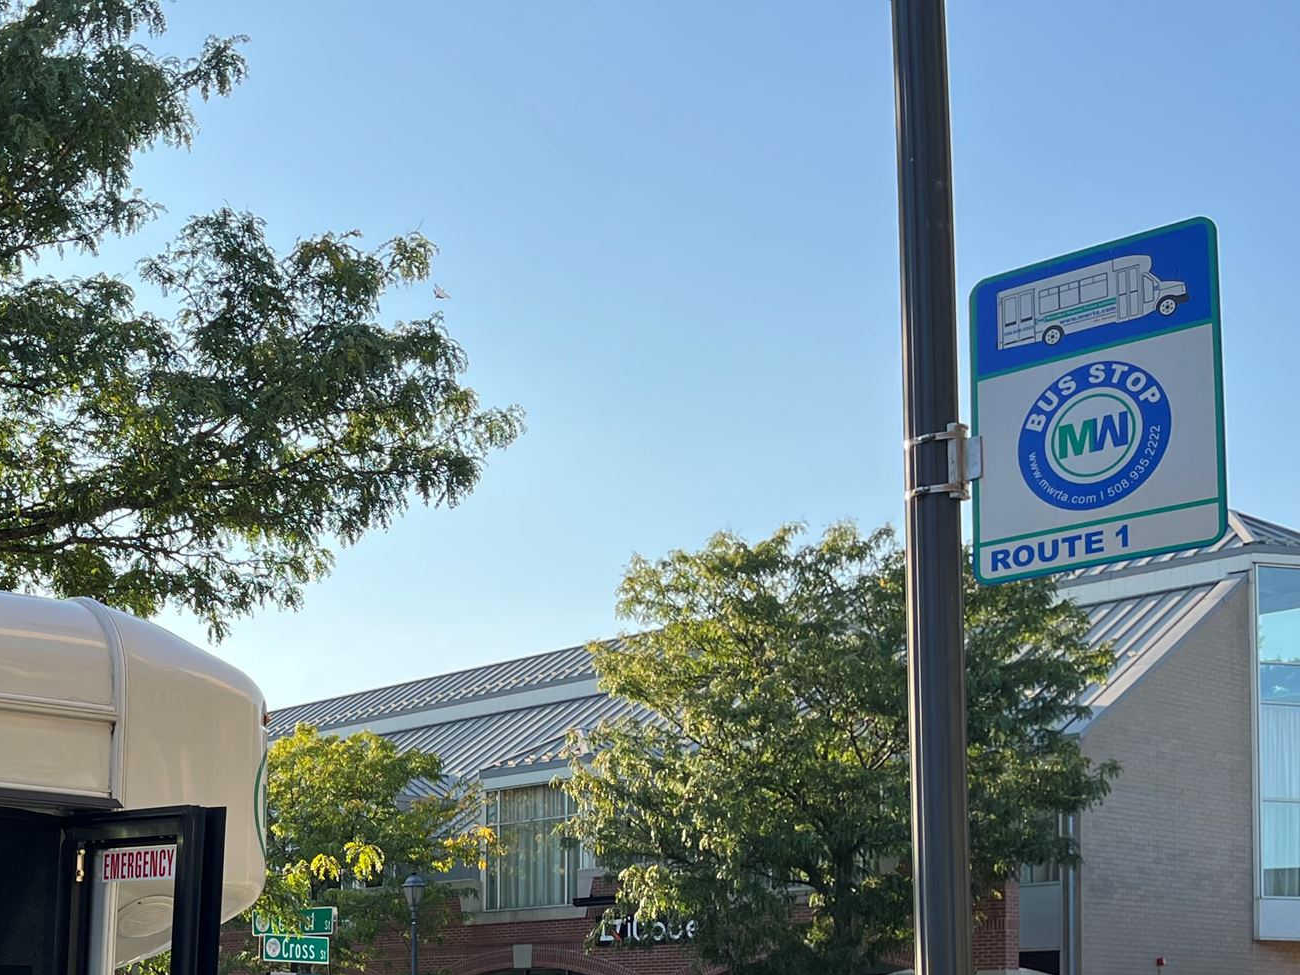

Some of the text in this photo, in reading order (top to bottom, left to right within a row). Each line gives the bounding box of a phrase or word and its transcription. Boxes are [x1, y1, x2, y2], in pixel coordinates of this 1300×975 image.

[1025, 363, 1161, 433] BUS STOP
[1058, 411, 1129, 460] MW
[1028, 451, 1097, 505] www.mwrta.com
[1107, 424, 1161, 498] 508.935.2222
[991, 524, 1130, 572] ROUTE 1
[103, 848, 175, 880] EMERGENCY
[282, 938, 327, 960] Cross St
[324, 920, 331, 931] St
